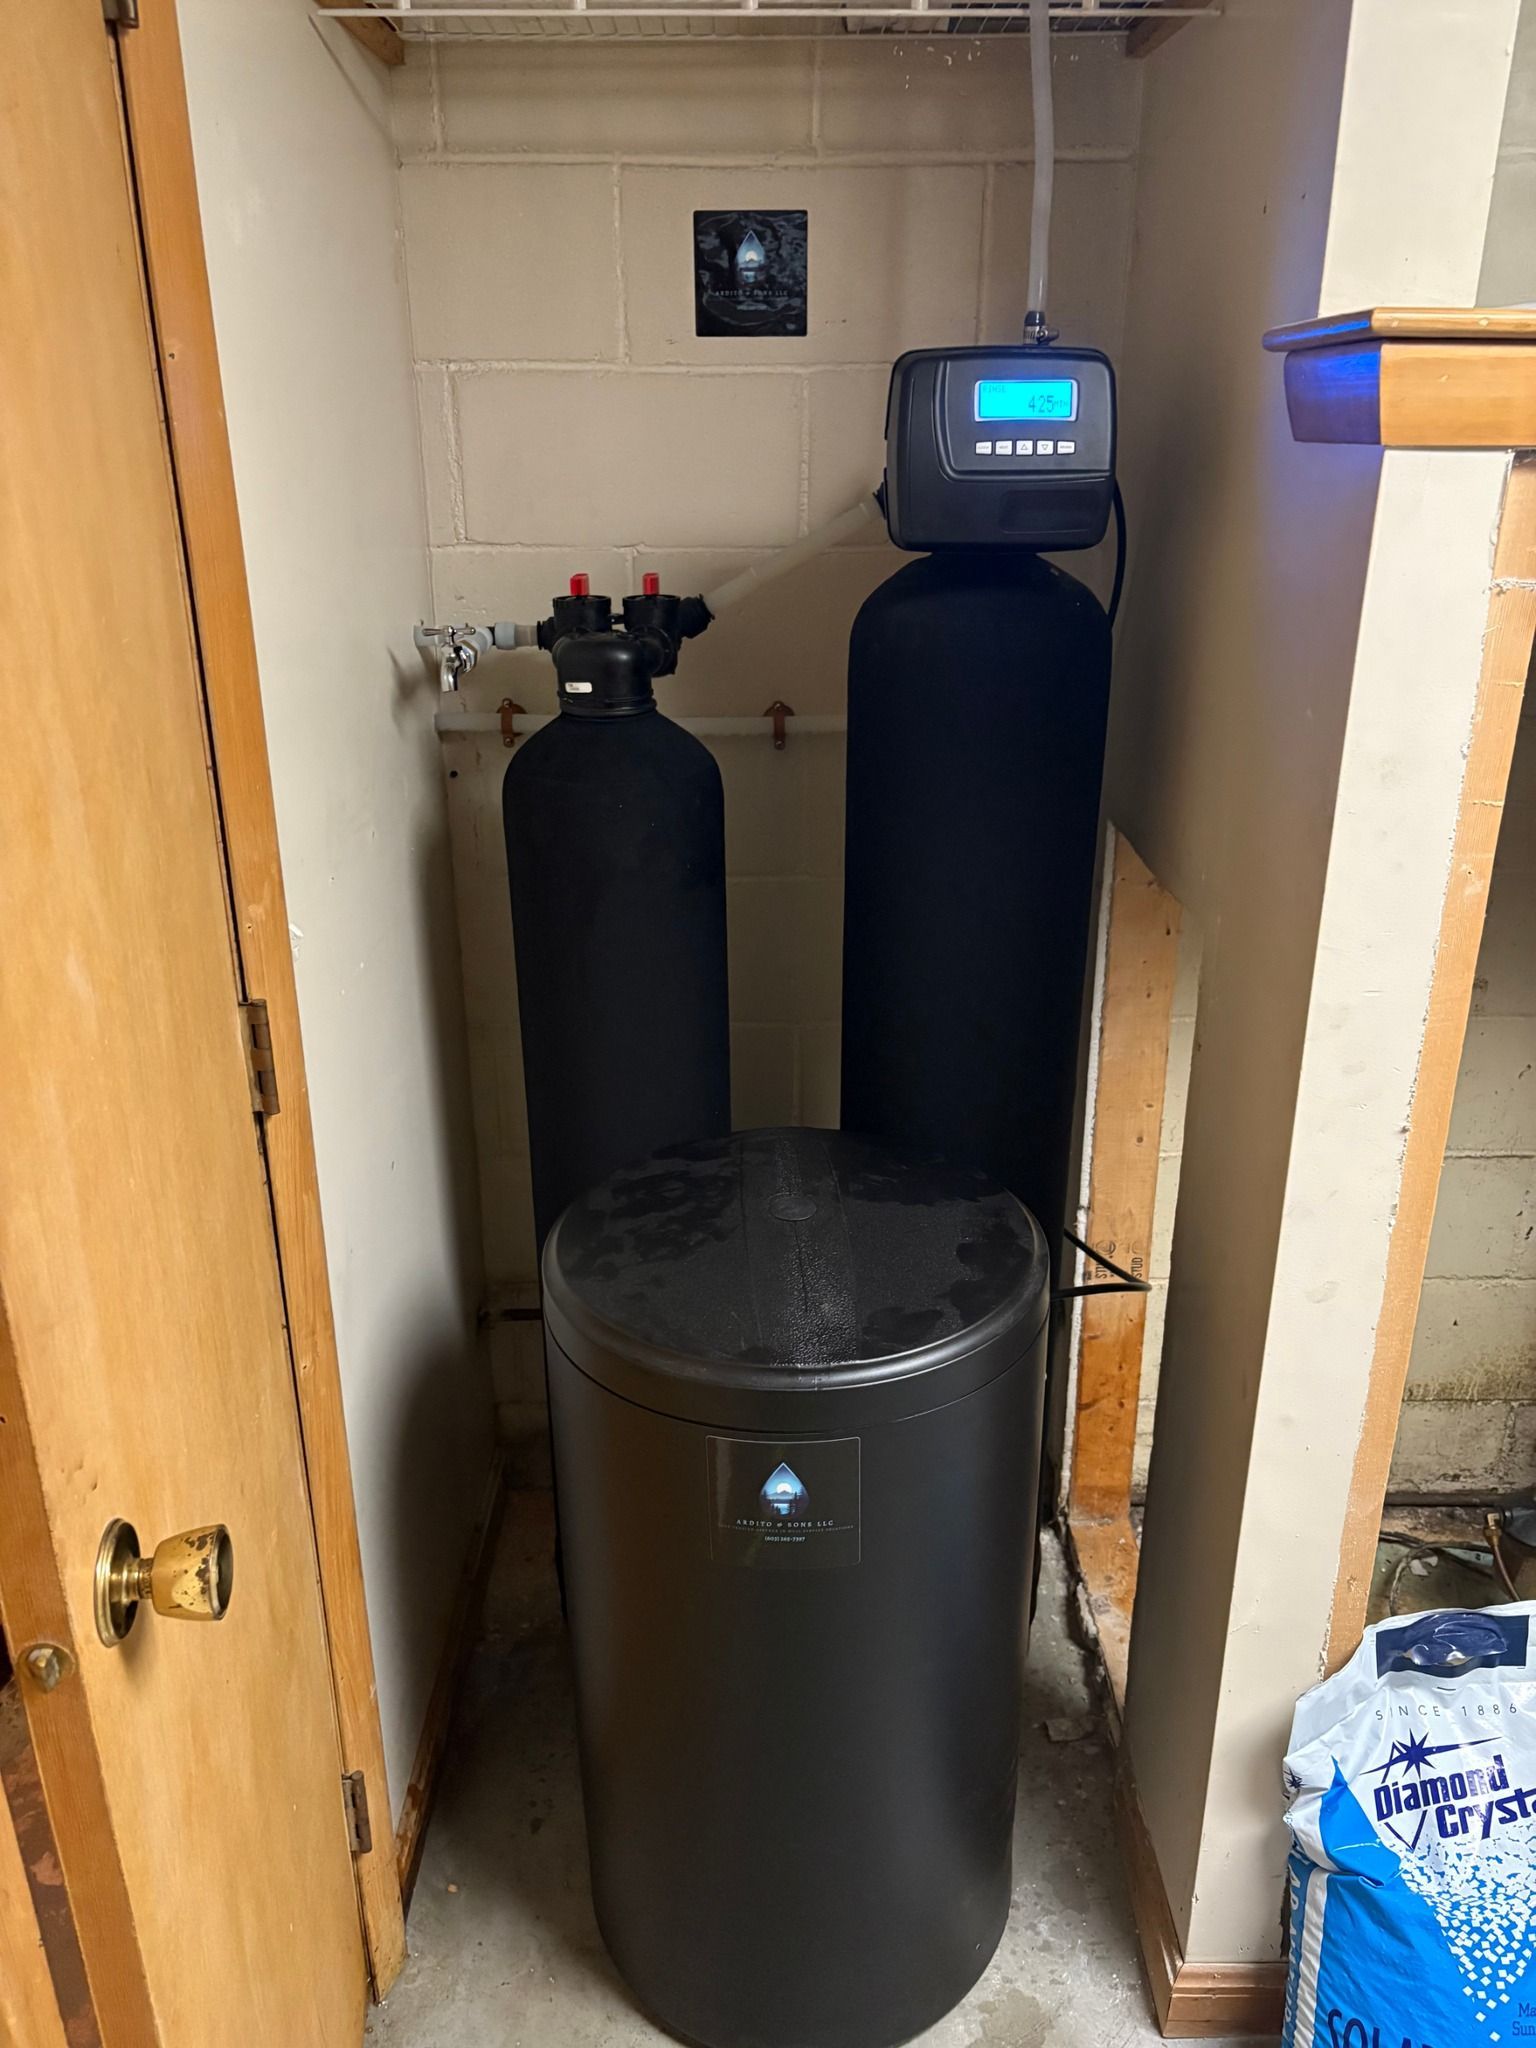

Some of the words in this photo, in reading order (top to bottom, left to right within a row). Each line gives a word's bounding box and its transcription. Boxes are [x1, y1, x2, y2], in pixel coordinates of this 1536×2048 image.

[736, 1519, 773, 1528] ARDITO
[817, 1519, 834, 1528] LLC
[1375, 1704, 1441, 1720] SINCE
[1461, 1703, 1517, 1717] 1886
[1373, 1754, 1510, 1822] Diamond
